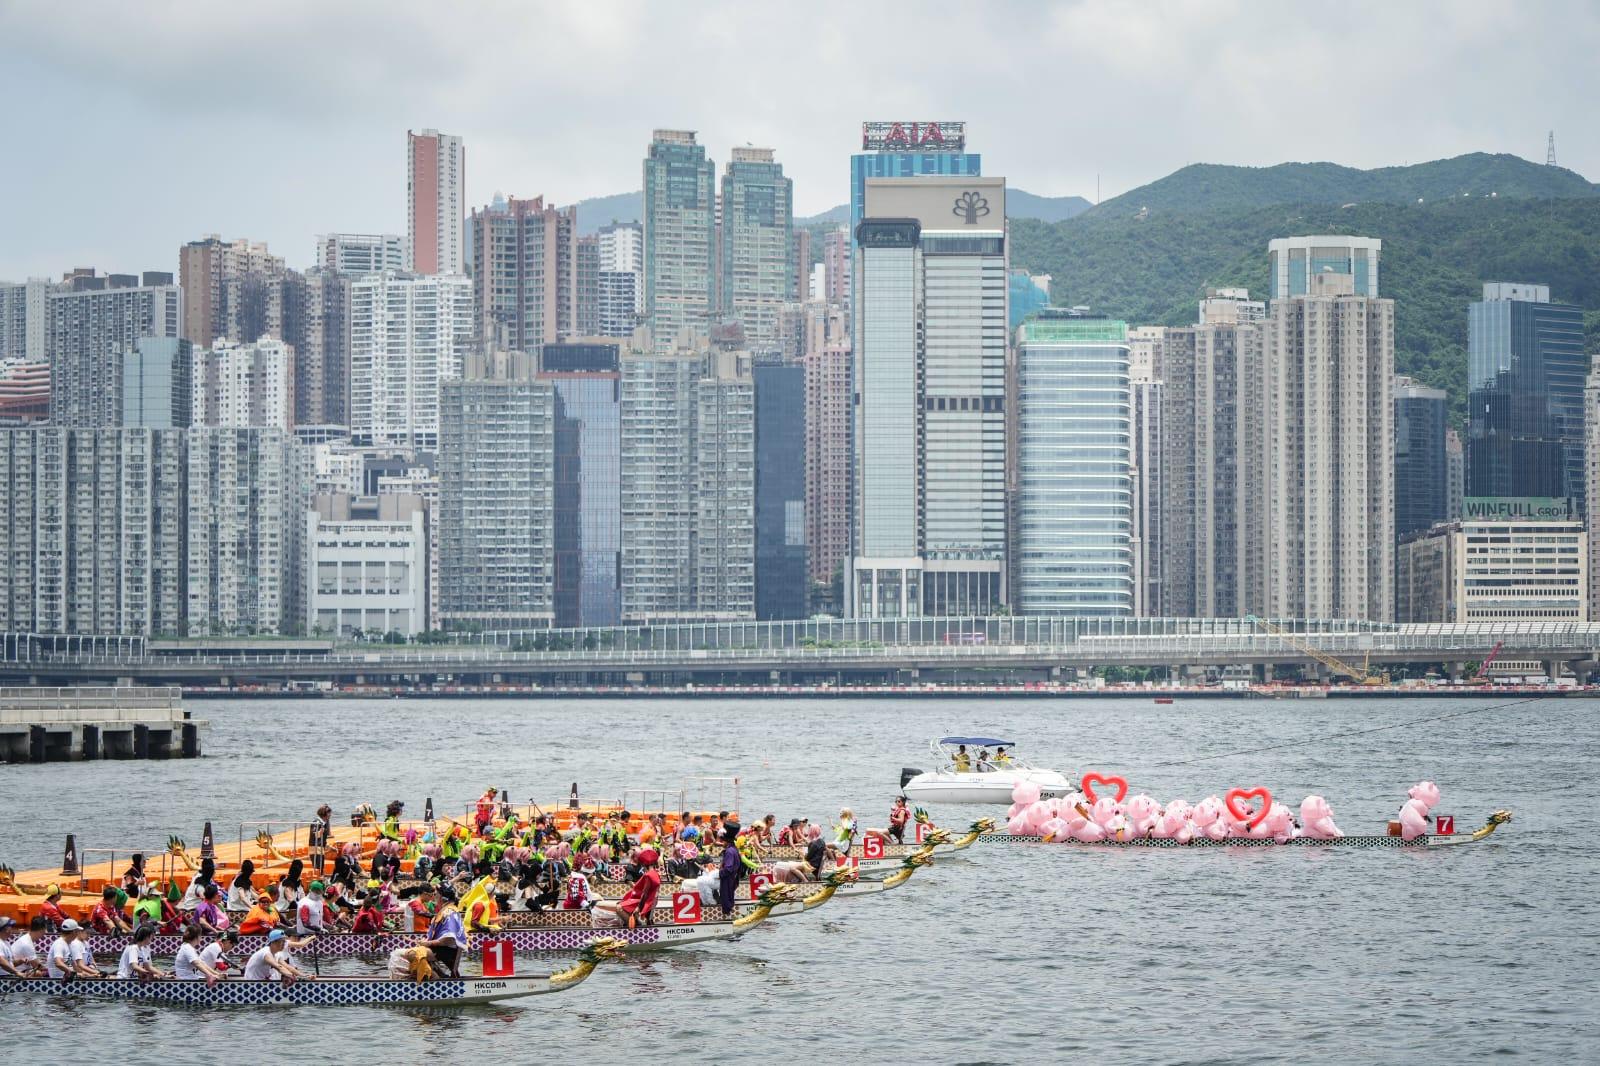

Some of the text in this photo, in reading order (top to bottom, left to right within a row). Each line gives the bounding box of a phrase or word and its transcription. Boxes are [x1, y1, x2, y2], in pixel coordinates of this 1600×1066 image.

[885, 122, 945, 145] AIA
[1467, 502, 1534, 517] WINFULL
[1438, 816, 1451, 832] 7
[203, 836, 210, 845] 5
[866, 837, 881, 856] 5
[65, 851, 73, 861] 4
[753, 875, 770, 897] 3
[677, 894, 696, 919] 2
[666, 927, 695, 935] HKCDBA
[489, 942, 503, 971] 1
[474, 981, 507, 990] HKCDBA
